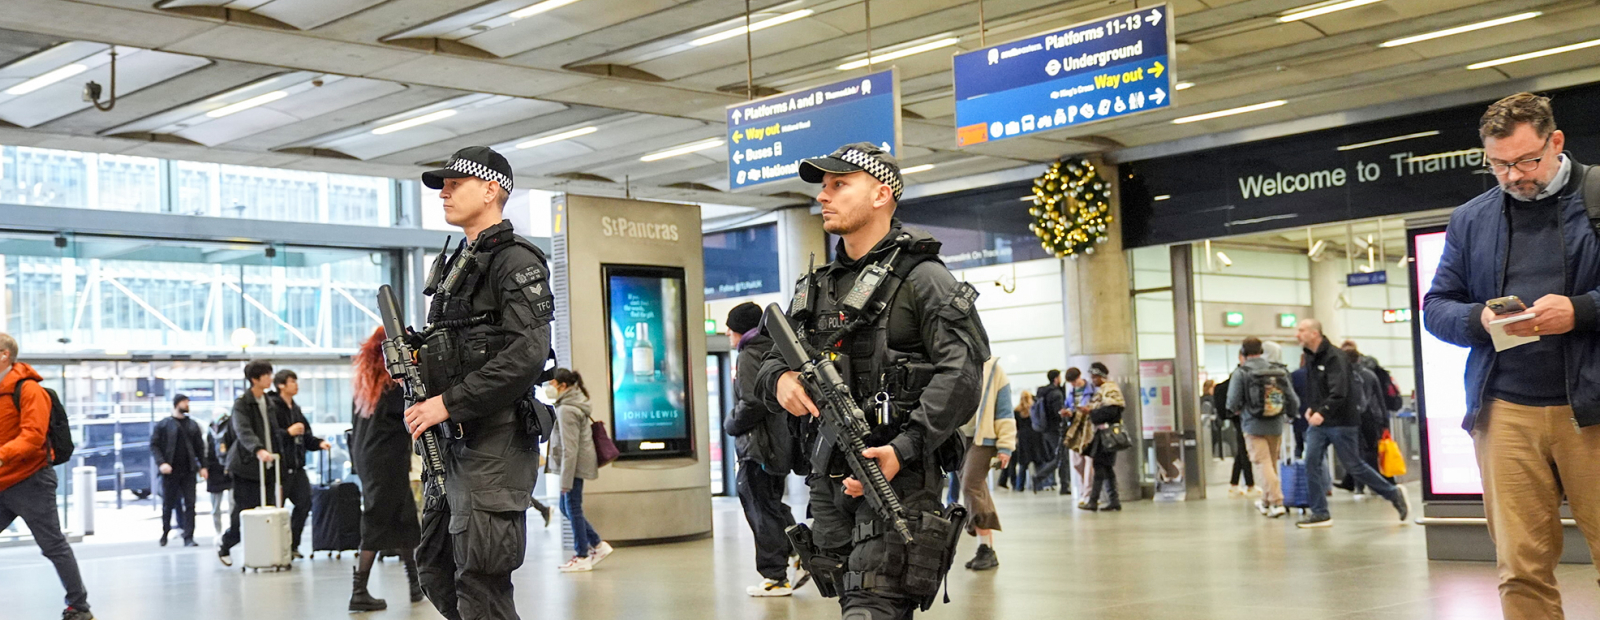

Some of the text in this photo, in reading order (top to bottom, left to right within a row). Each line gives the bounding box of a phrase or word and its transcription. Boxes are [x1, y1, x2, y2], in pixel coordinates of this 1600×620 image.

[1045, 26, 1104, 51] Platforms
[1106, 14, 1142, 36] 11-13
[1063, 39, 1143, 72] Underground
[1094, 73, 1121, 89] Way
[1122, 67, 1143, 83] out
[744, 102, 788, 121] Platforms
[788, 98, 797, 111] A
[797, 93, 815, 109] and
[815, 91, 824, 105] B
[745, 127, 765, 140] Way
[765, 122, 780, 136] out
[745, 147, 773, 161] Buses
[761, 160, 799, 179] National
[1239, 147, 1490, 199] Welcome to Thame
[971, 250, 982, 260] On
[525, 269, 540, 277] POLICE
[536, 300, 551, 311] TFC
[623, 409, 679, 420] JOHN LEWIS
